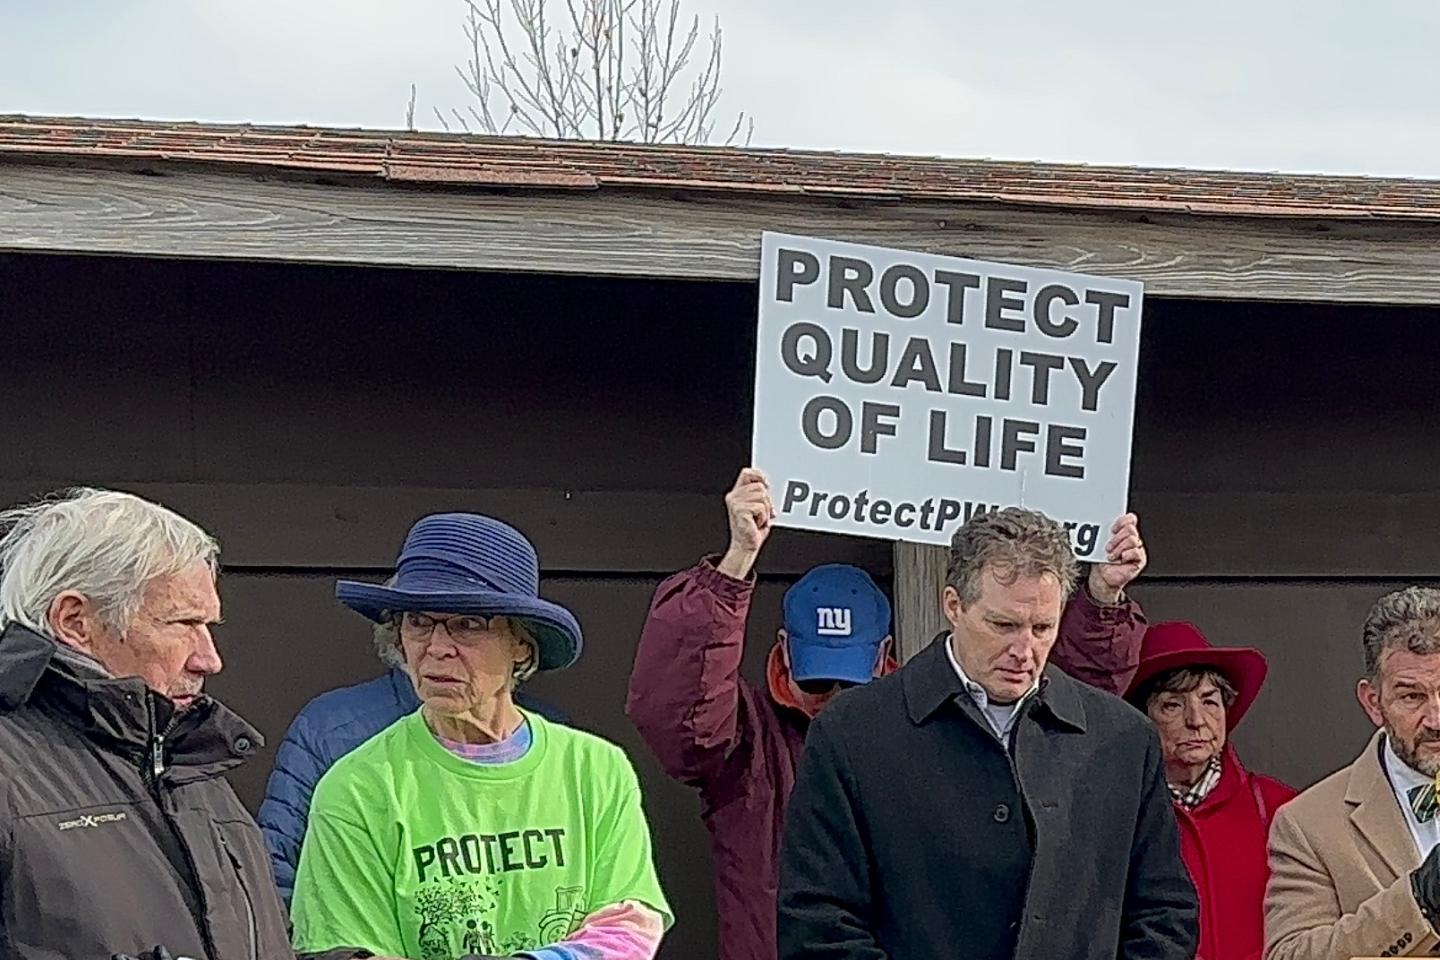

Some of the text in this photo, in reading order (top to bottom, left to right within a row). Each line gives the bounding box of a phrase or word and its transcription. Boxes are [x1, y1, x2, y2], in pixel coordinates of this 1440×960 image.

[775, 248, 1130, 344] PROTECT
[781, 321, 1118, 411] QUALITY
[801, 396, 1088, 479] OF LIFE
[412, 828, 566, 883] PROTECT
